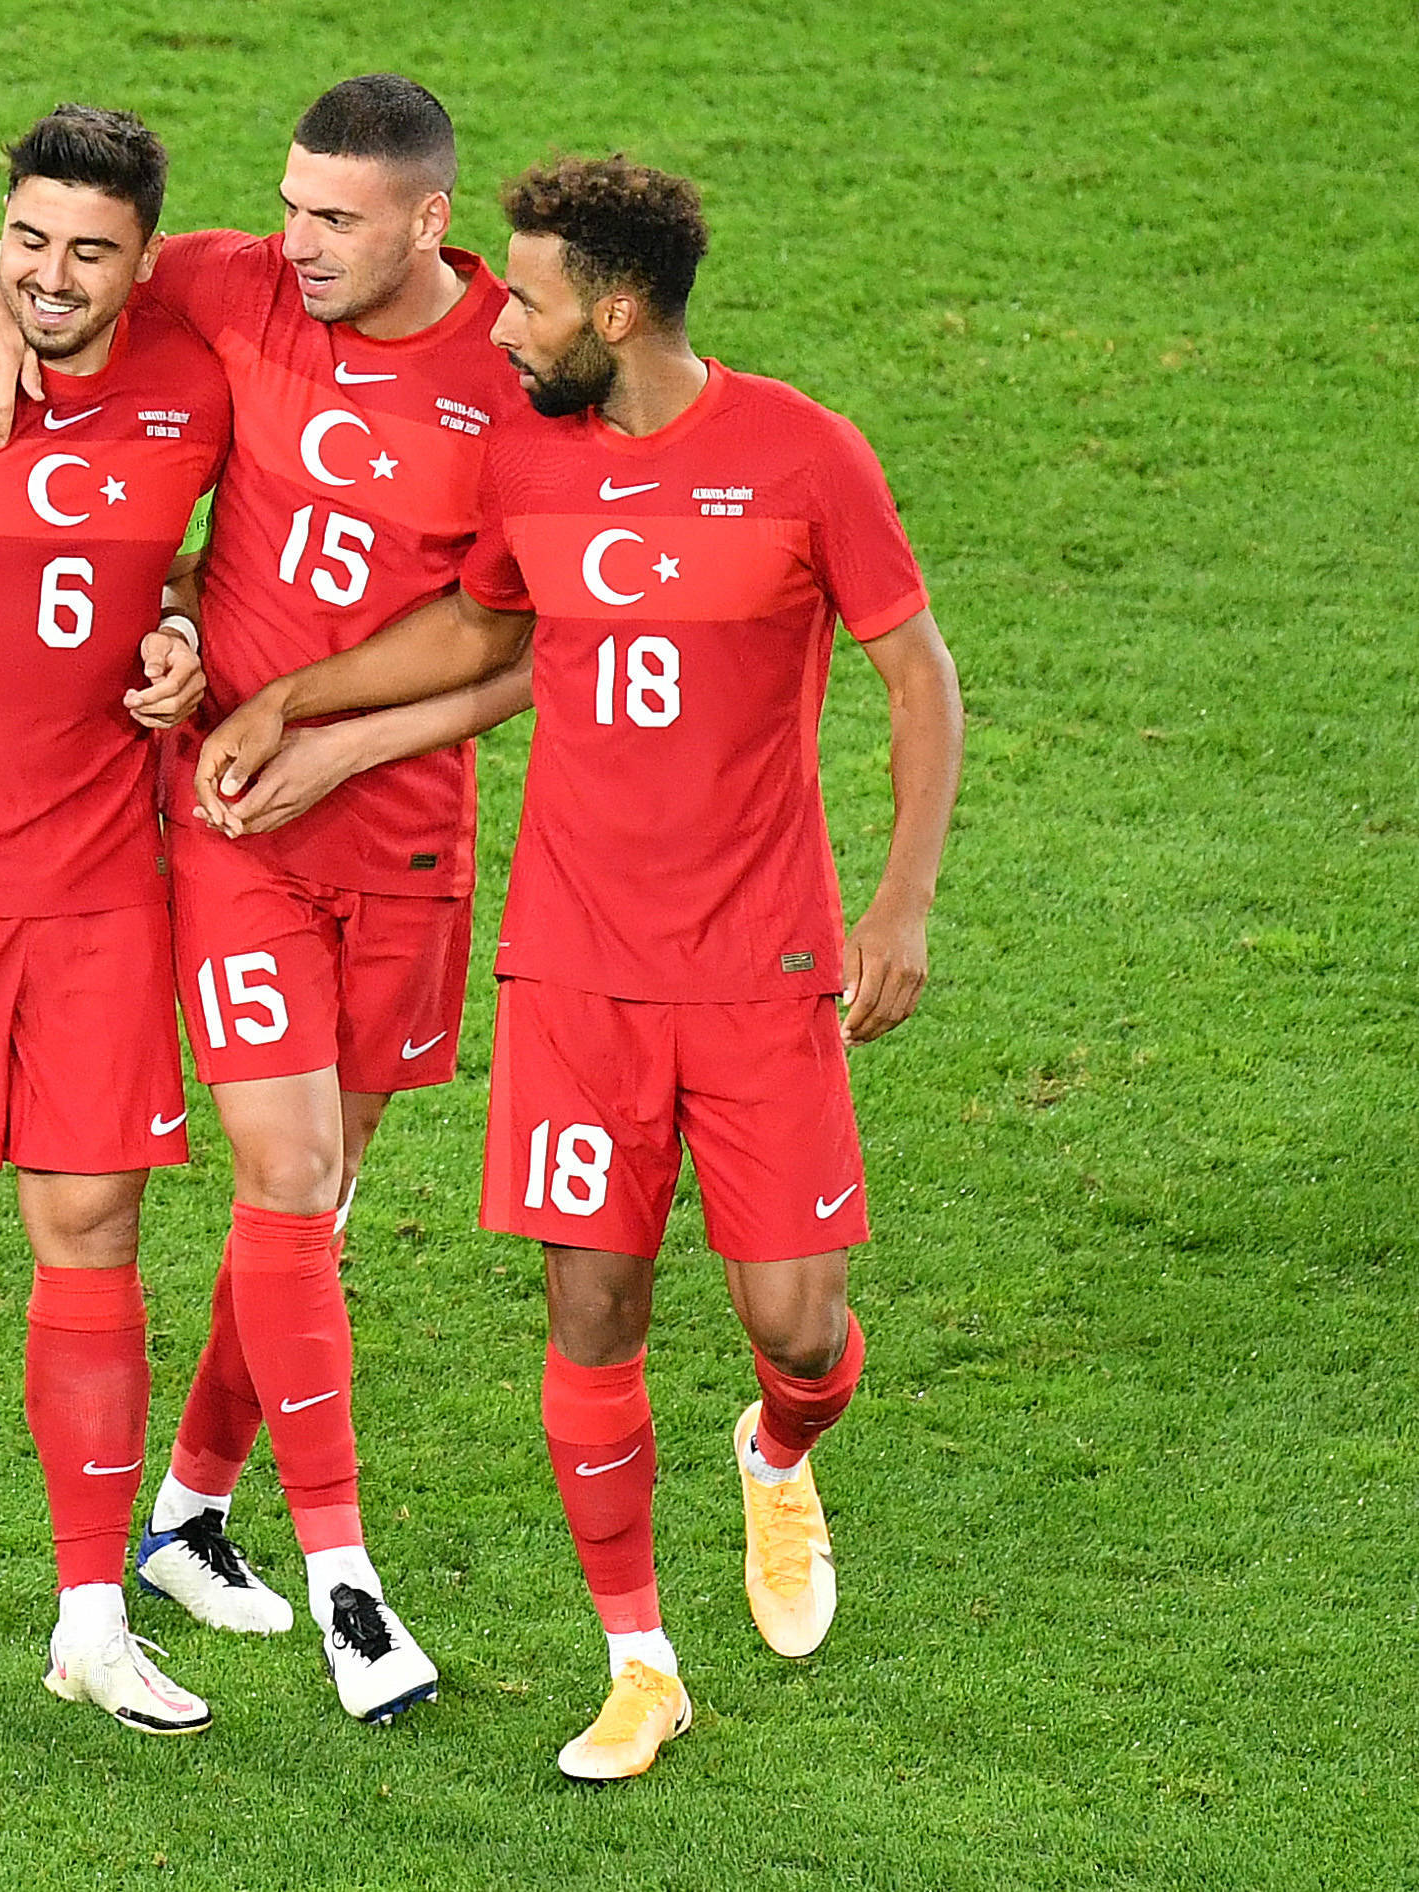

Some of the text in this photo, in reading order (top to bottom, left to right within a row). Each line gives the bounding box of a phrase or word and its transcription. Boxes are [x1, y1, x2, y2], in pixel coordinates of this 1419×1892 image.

[37, 557, 94, 649] 6
[278, 504, 375, 607] 15
[596, 635, 680, 728] 18
[197, 951, 289, 1049] 15
[524, 1119, 613, 1217] 18
